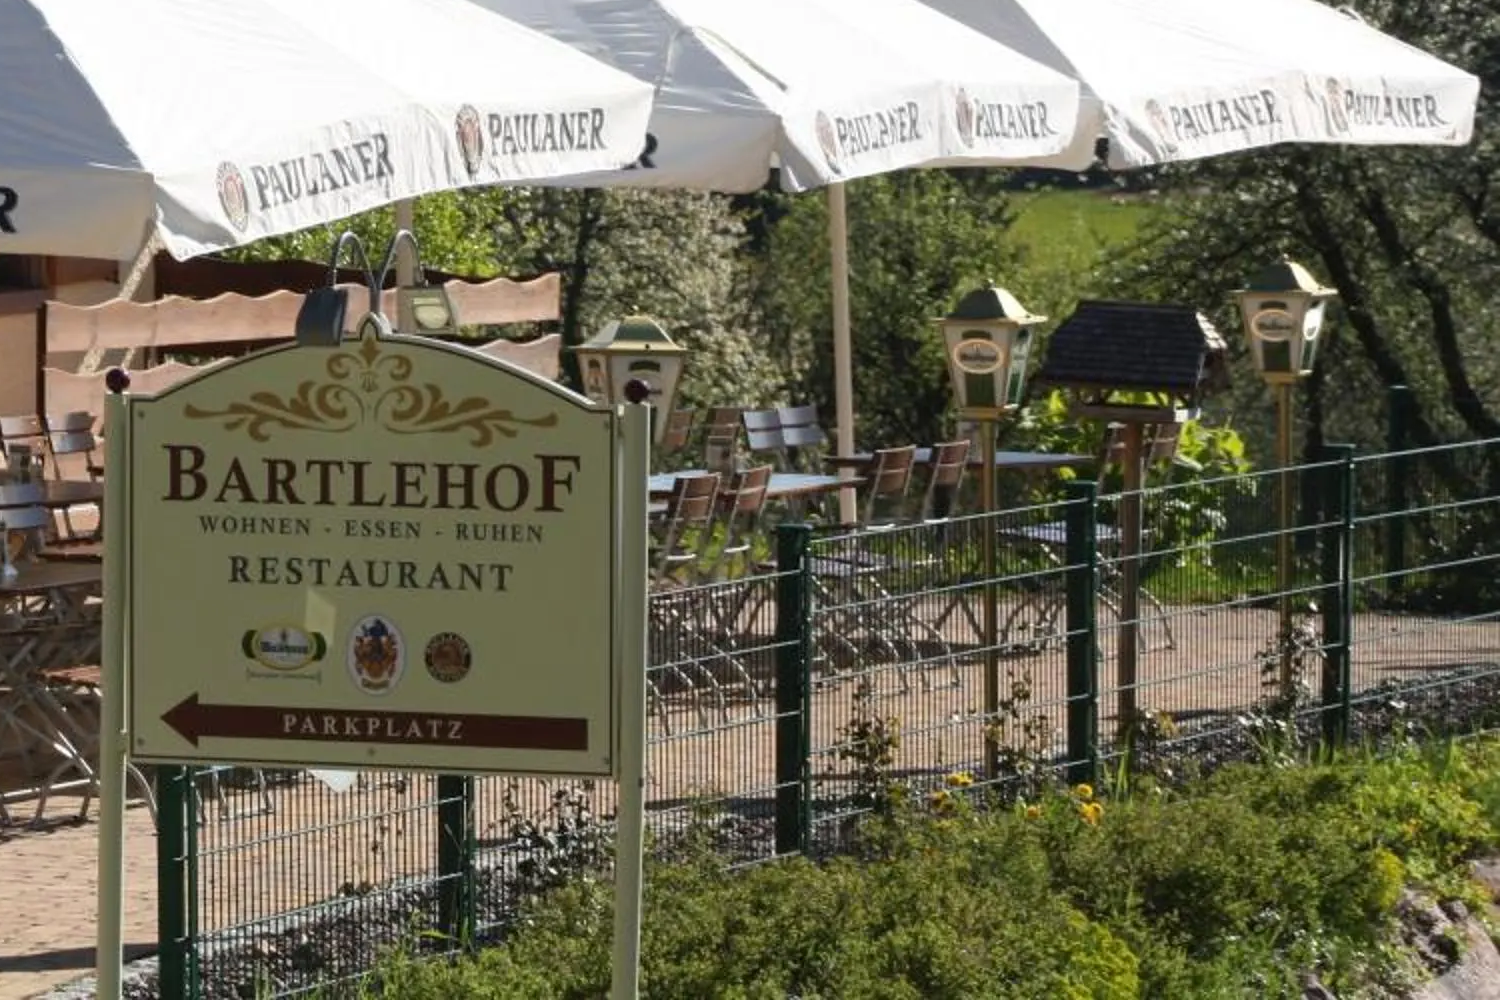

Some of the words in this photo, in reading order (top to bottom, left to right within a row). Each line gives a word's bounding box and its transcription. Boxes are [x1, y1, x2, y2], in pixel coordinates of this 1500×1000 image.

[1169, 89, 1282, 140] PAULANER
[1343, 90, 1450, 128] PAULANER
[487, 107, 608, 157] PAULANER
[250, 133, 395, 210] PAULANER
[161, 443, 581, 512] BARTLEHOF
[199, 515, 311, 536] WOHNEN
[344, 520, 421, 539] ESSEN
[455, 523, 544, 543] RUHEN
[227, 556, 514, 592] RESTAURANT
[282, 714, 465, 739] PARKPLATZ
